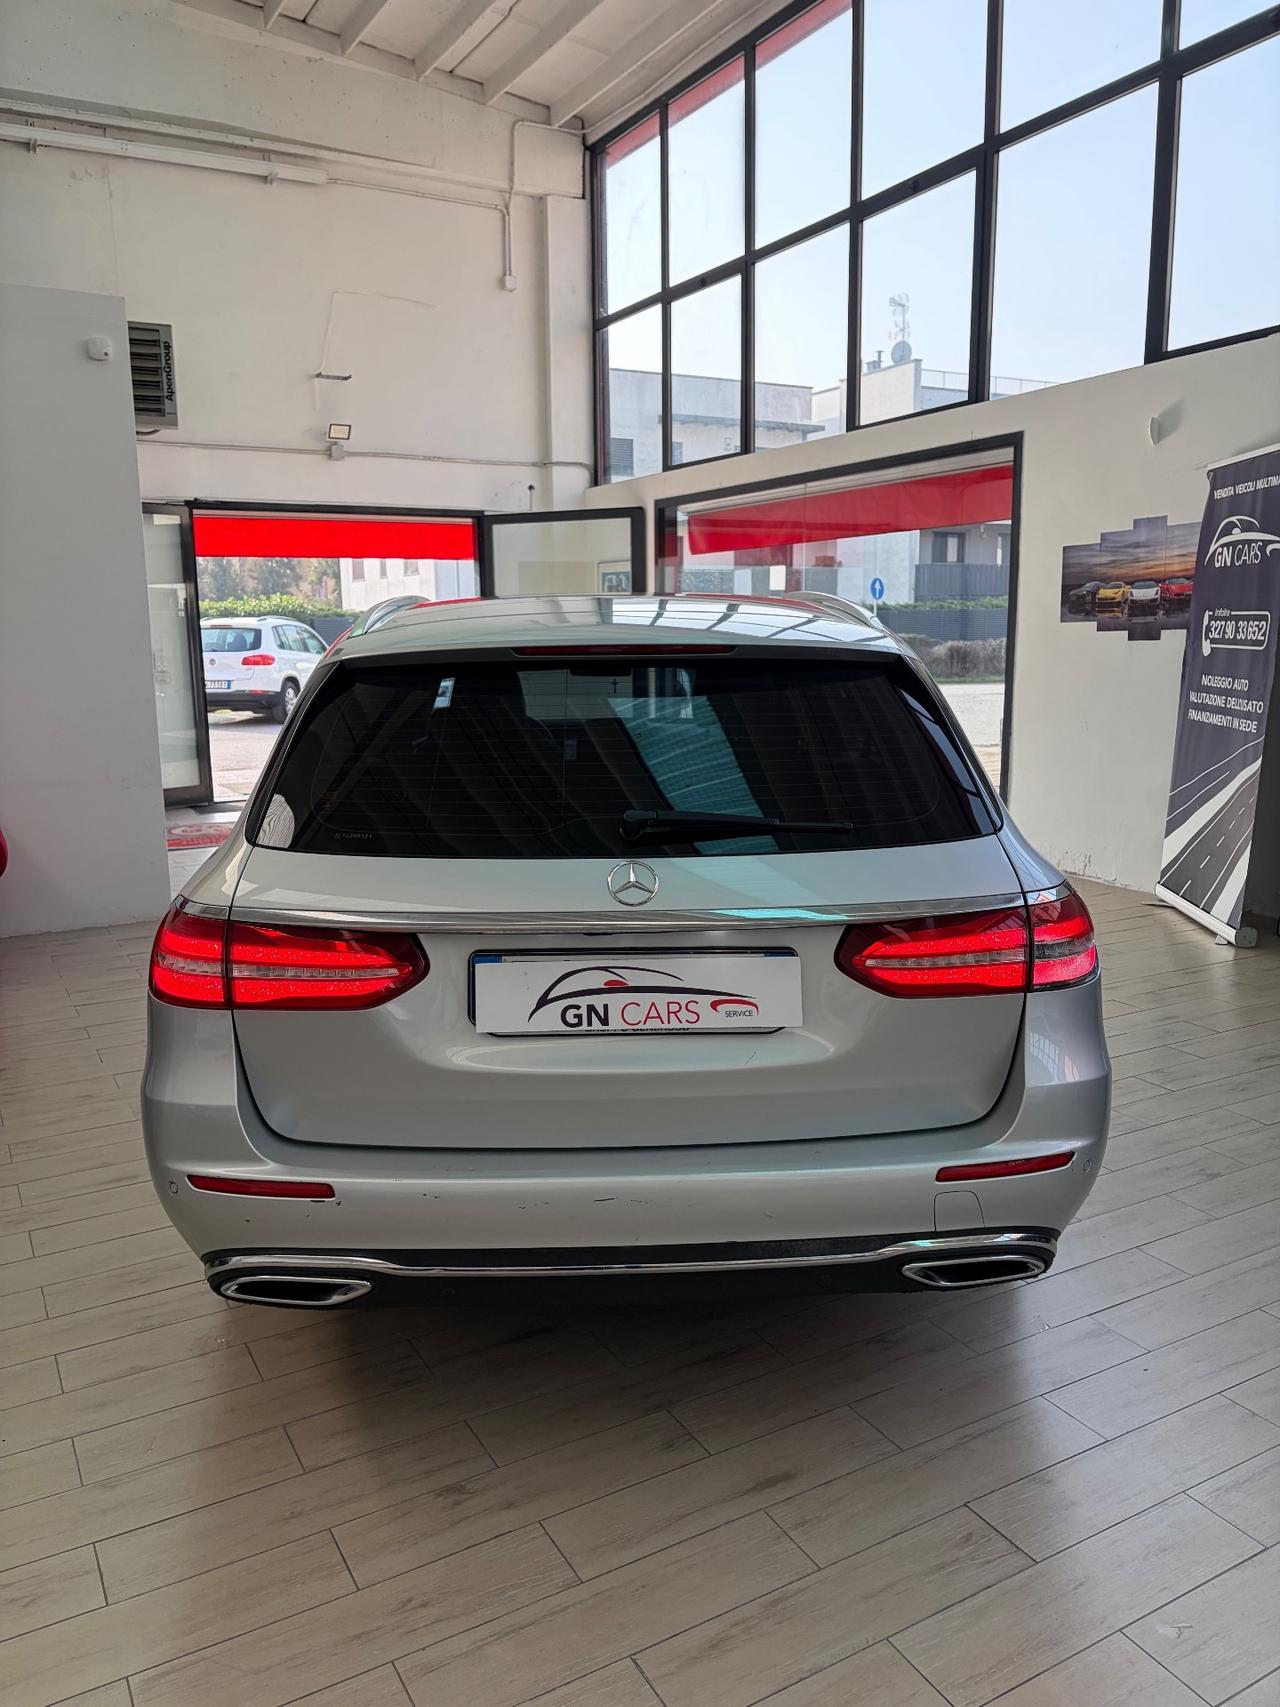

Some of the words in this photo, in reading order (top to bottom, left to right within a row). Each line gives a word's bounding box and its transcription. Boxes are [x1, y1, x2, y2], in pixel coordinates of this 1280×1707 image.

[163, 341, 175, 402] ApenGroup
[1214, 486, 1235, 500] VENDITA
[1214, 545, 1233, 568] GN
[1234, 541, 1263, 566] CARS
[1201, 674, 1233, 689] NOLEGGIO
[1233, 678, 1249, 692] AUTO
[1239, 719, 1258, 733] SEDE
[560, 1003, 610, 1028] GN
[621, 999, 701, 1026] CARS
[724, 1009, 754, 1018] SERVICE
